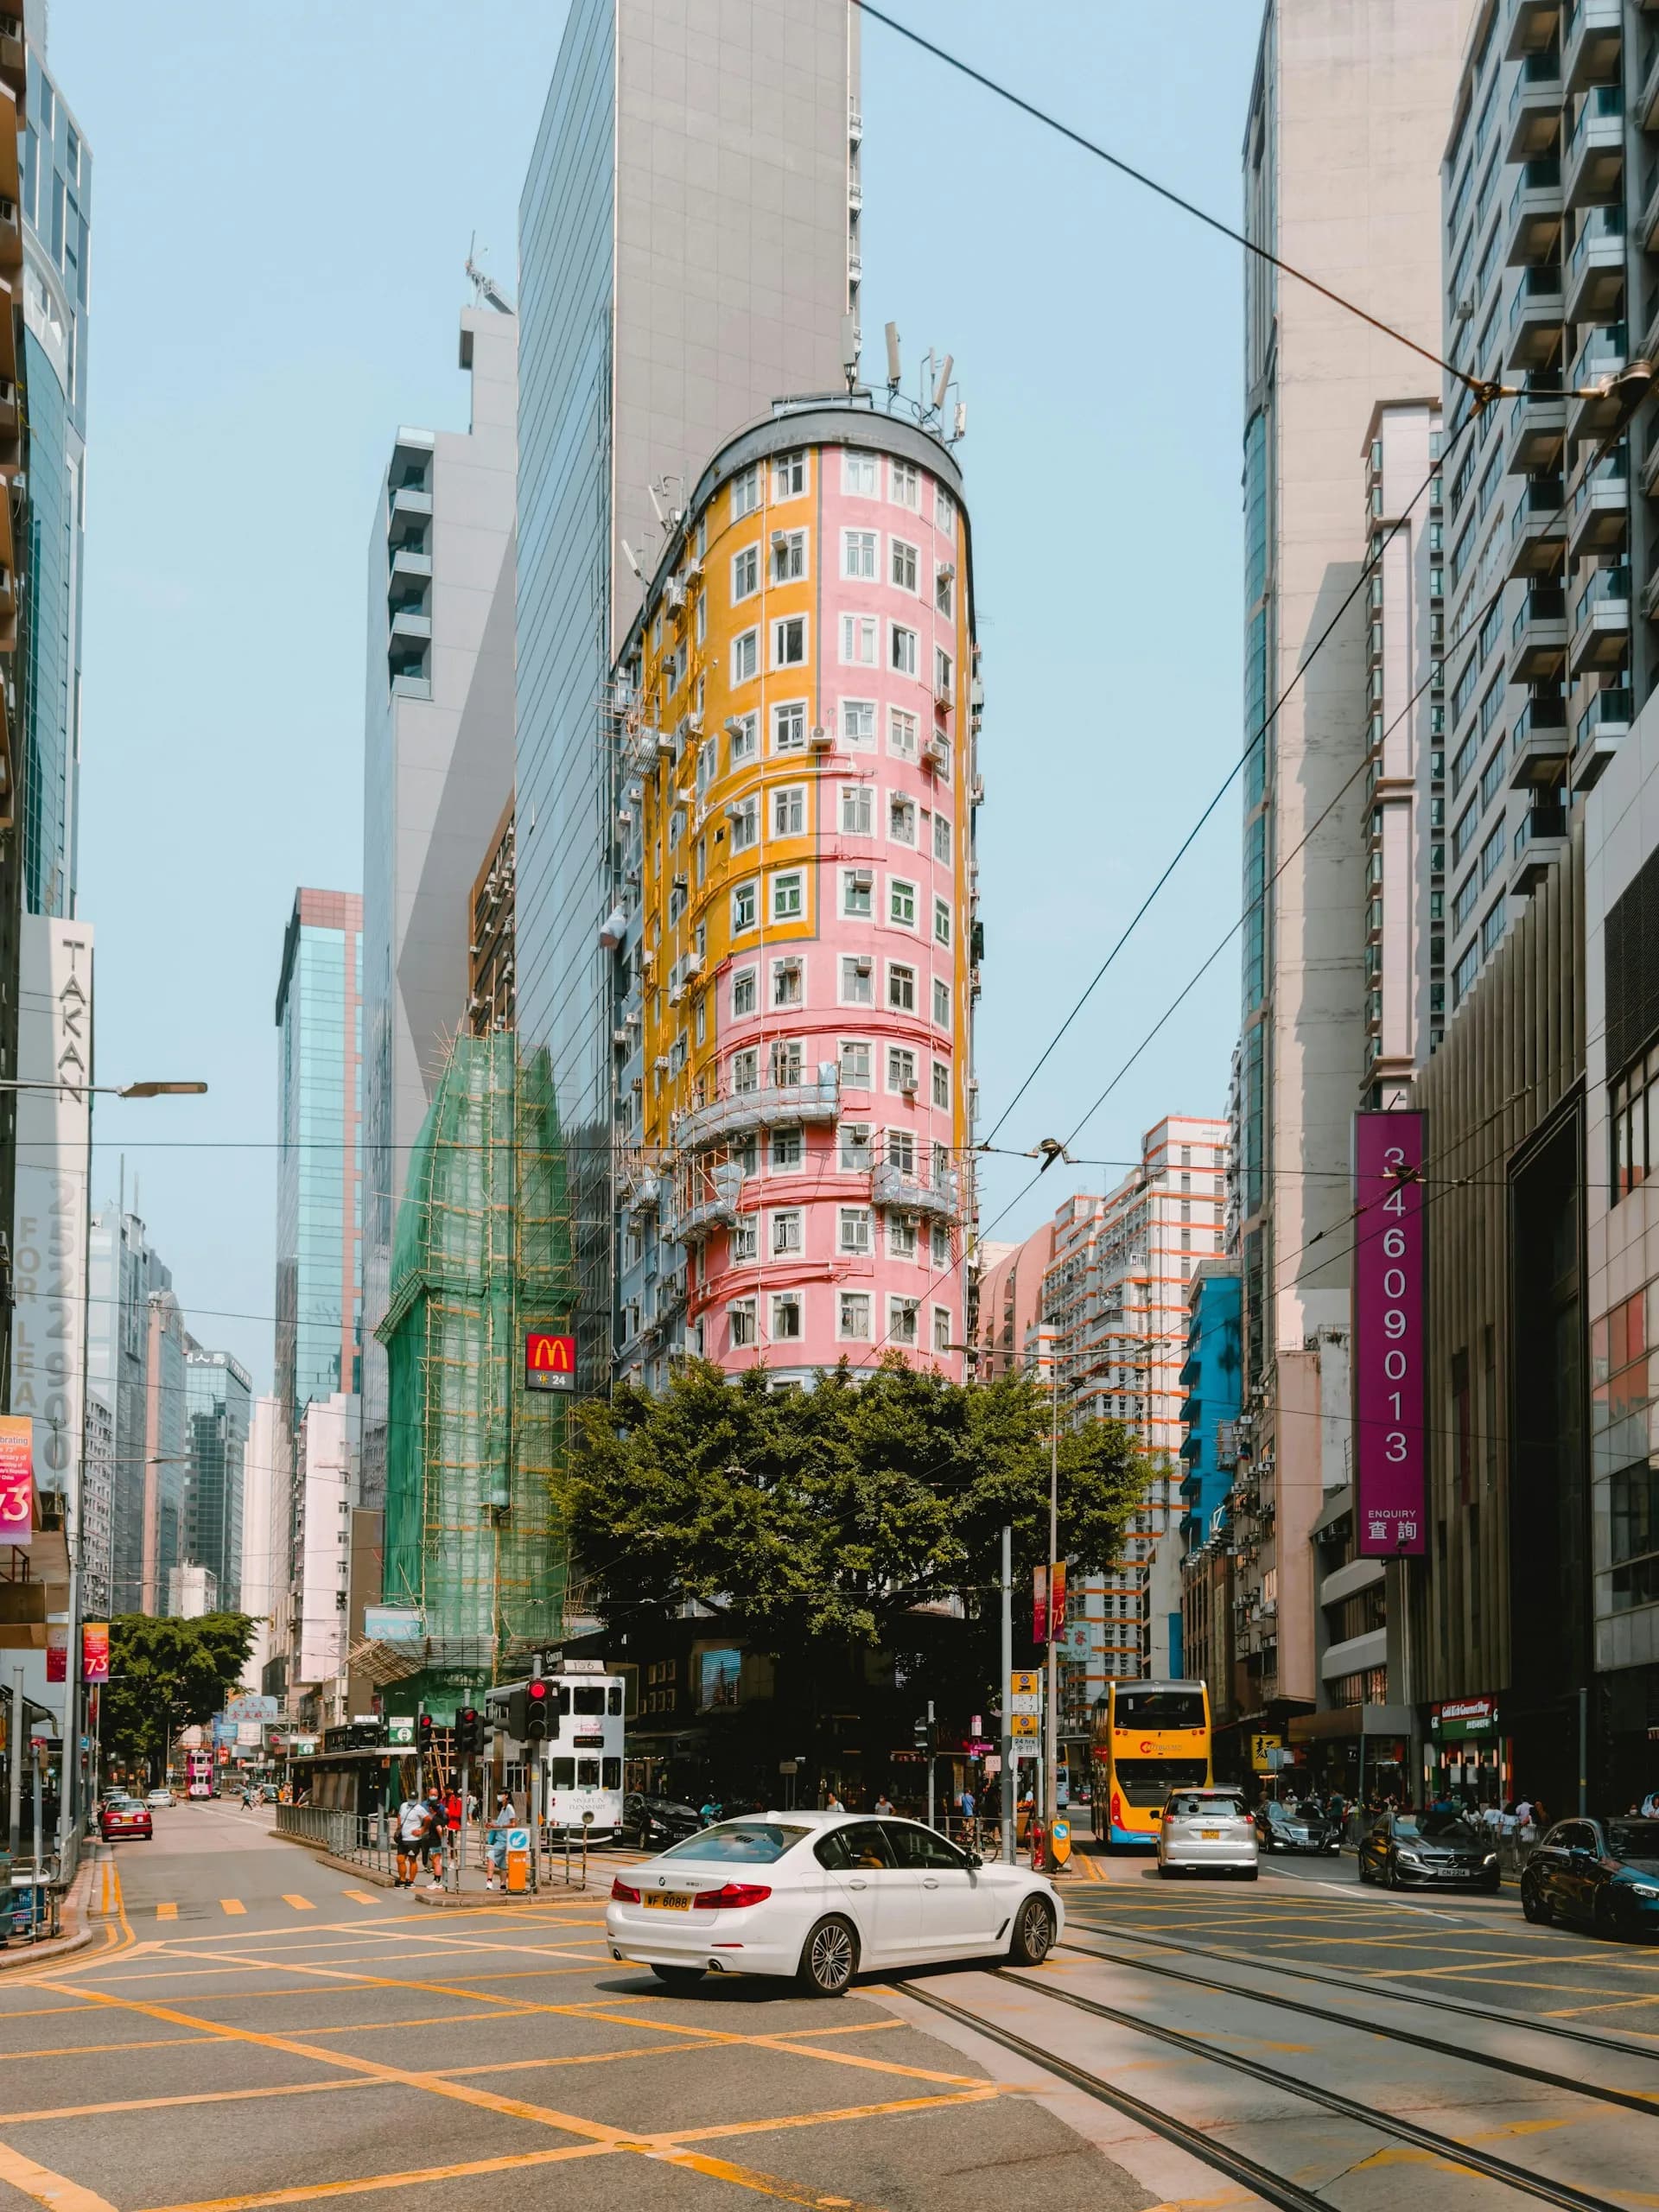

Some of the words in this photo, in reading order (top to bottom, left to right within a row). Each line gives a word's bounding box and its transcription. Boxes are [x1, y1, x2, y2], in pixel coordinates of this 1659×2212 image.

[59, 938, 86, 1105] TAKAN
[15, 1217, 41, 1303] FOR
[14, 1321, 37, 1418] LEA
[552, 1375, 566, 1385] 24
[1368, 1510, 1416, 1518] ENQUIRY
[1368, 1521, 1417, 1540] 查詢
[85, 1655, 107, 1675] 73
[648, 1895, 659, 1906] WF
[663, 1896, 688, 1909] 6088
